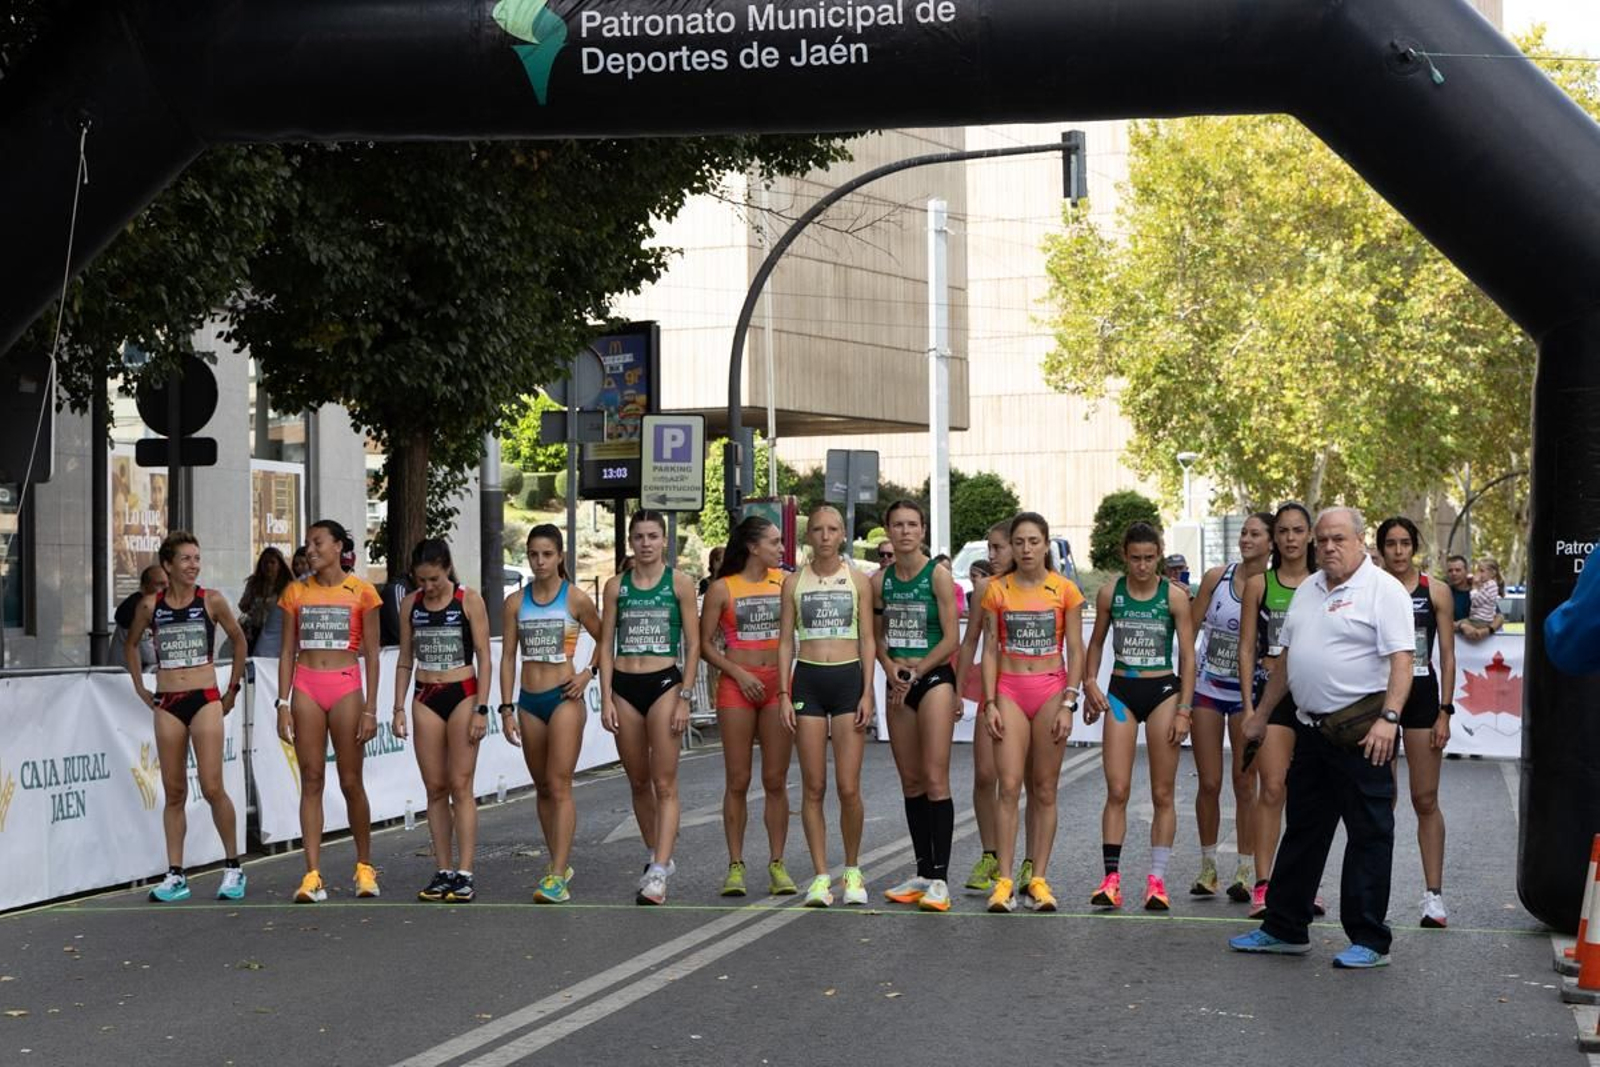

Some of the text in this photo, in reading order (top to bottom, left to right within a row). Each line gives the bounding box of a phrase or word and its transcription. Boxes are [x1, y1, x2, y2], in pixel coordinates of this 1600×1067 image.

[581, 0, 956, 38] Patronato Municipal de
[581, 36, 868, 80] Deportes de Jaén
[662, 427, 685, 459] P
[602, 467, 628, 479] 13:03
[653, 465, 692, 473] PARKING
[125, 501, 161, 533] Lo que
[266, 512, 289, 534] Paso
[1574, 558, 1585, 573] D
[816, 608, 839, 618] ZOYA
[301, 622, 349, 630] ANA PATRICIA
[811, 619, 844, 628] NAUMOV
[628, 626, 661, 634] MIREYA
[1016, 629, 1046, 638] CARLA
[313, 632, 334, 640] SILVA
[625, 636, 666, 644] ARNEDILLO
[1123, 636, 1154, 647] MARTA
[160, 639, 203, 651] CAROLINA
[420, 644, 458, 653] CRISTINA
[168, 649, 198, 660] ROBLES
[1121, 647, 1156, 656] MITJANS
[1216, 648, 1238, 660] MAR
[425, 654, 453, 662] ESPEJO
[20, 752, 110, 790] CAJA RURAL
[51, 786, 86, 824] JAÉN
